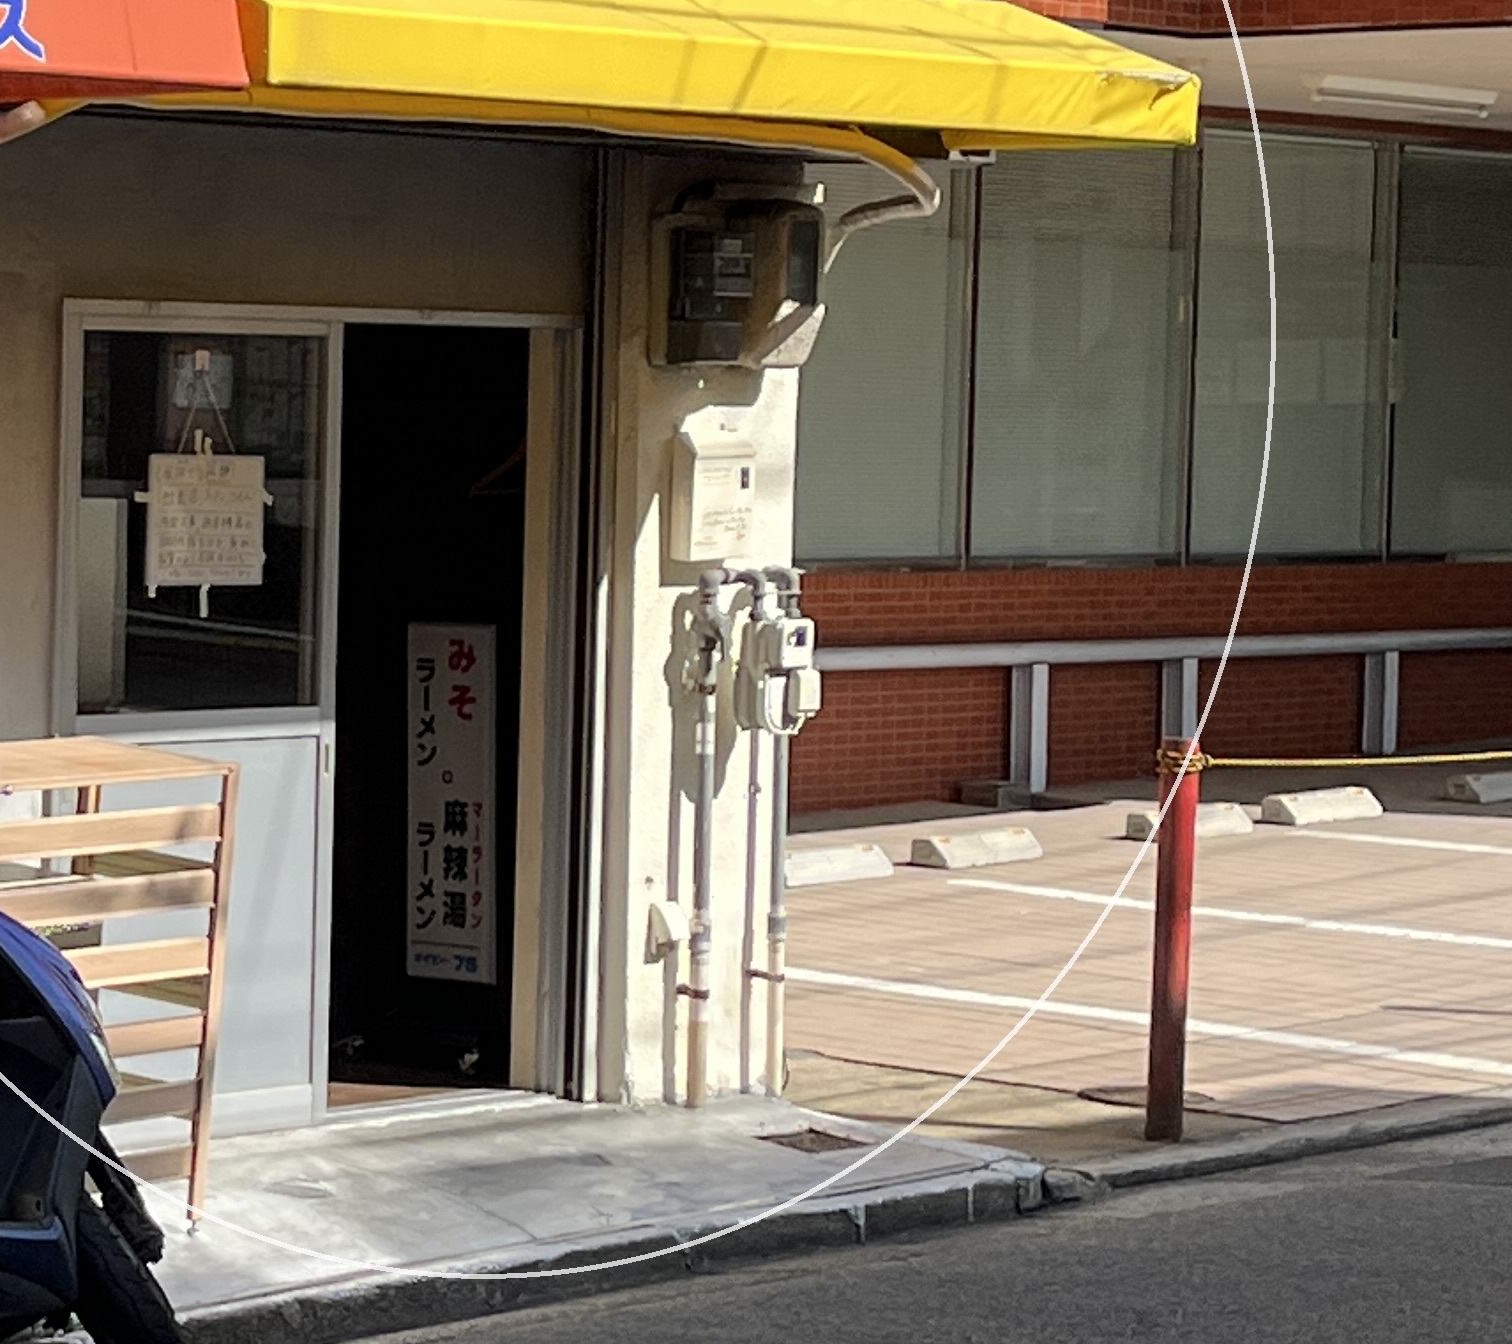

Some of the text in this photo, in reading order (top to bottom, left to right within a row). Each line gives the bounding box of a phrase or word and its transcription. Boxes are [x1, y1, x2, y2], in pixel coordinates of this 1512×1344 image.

[416, 657, 437, 766] ラーメン
[448, 638, 477, 721] みそ
[416, 821, 437, 930] ラーメン
